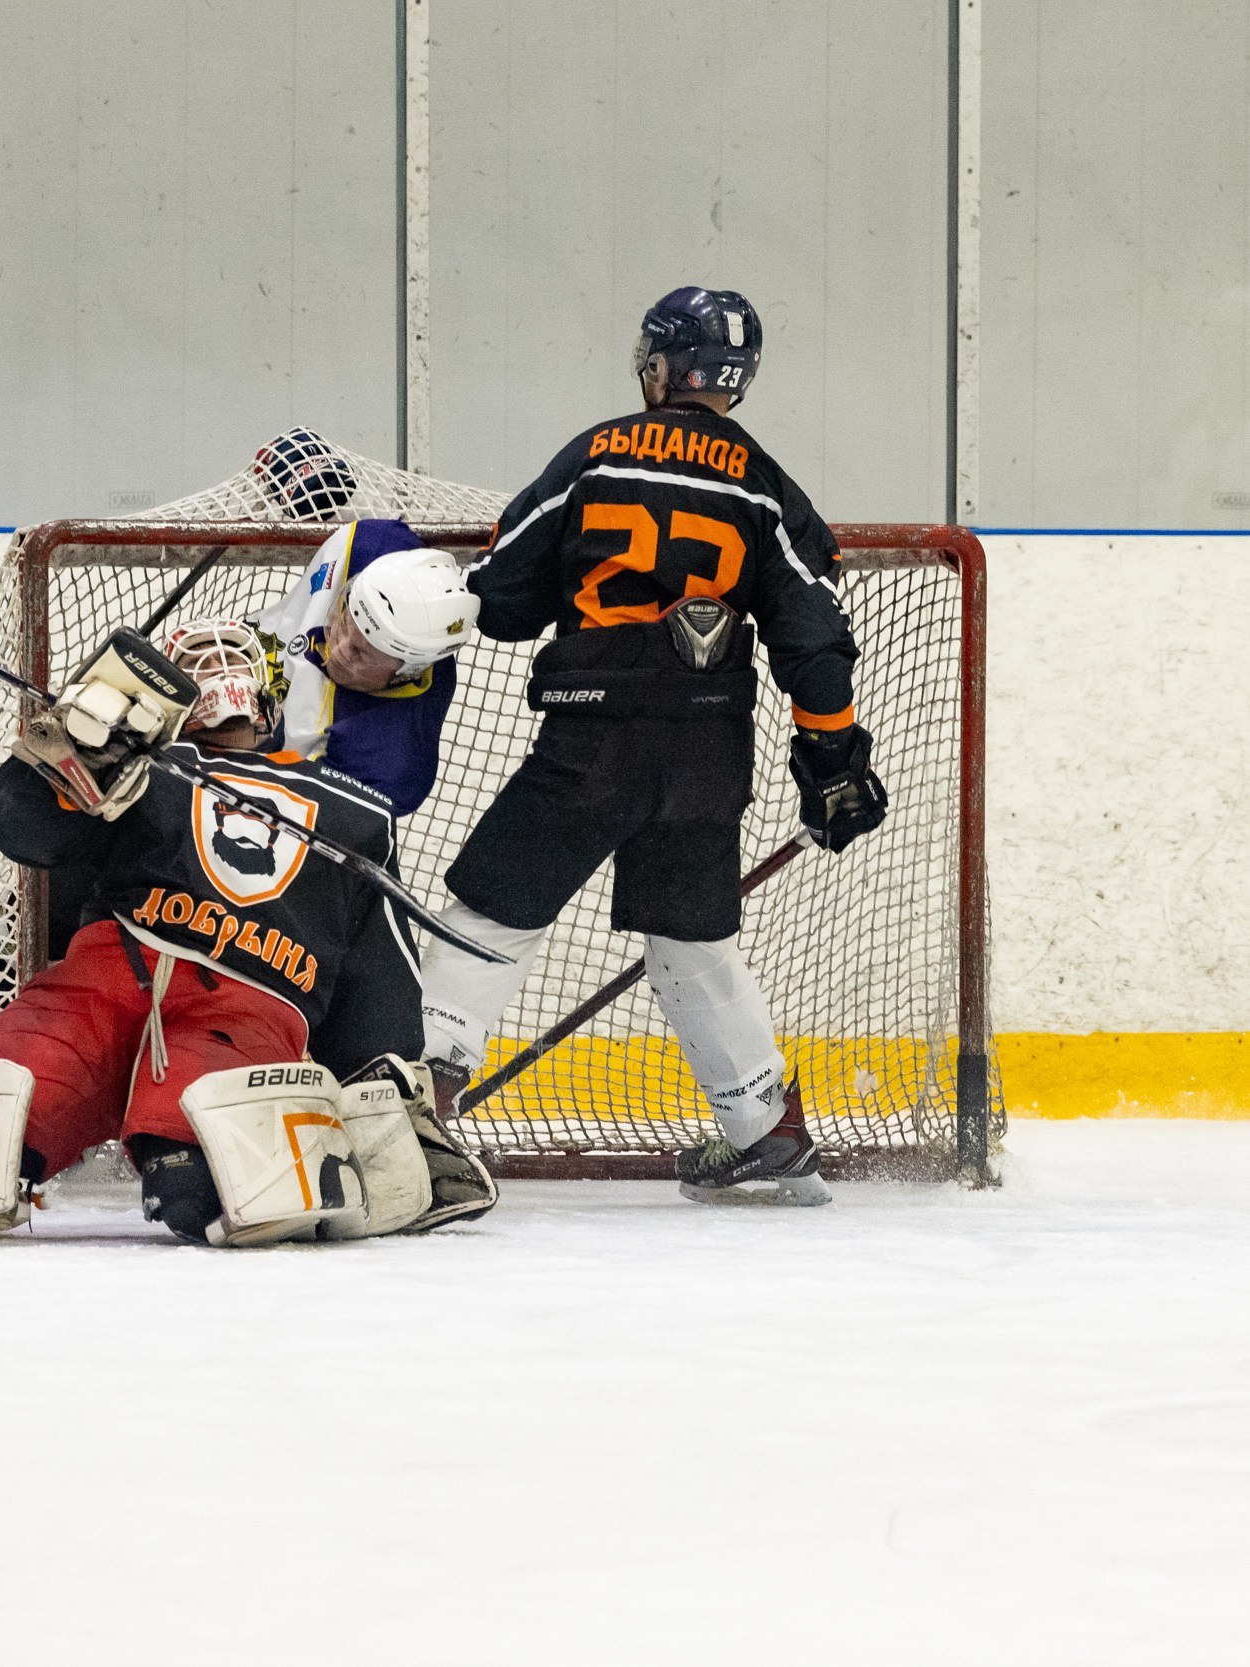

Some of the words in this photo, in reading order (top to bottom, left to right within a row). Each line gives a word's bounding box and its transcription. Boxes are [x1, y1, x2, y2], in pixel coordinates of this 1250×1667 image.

[716, 364, 744, 388] 23
[589, 422, 749, 480] БЫДАНОВ
[123, 647, 188, 698] BAUER
[540, 689, 606, 704] BAUER
[822, 779, 849, 796] CCM
[133, 887, 319, 993] ДОБРЫНЯ
[247, 1067, 324, 1089] BAUER
[360, 1087, 396, 1102] S170
[731, 1157, 763, 1179] CCM
